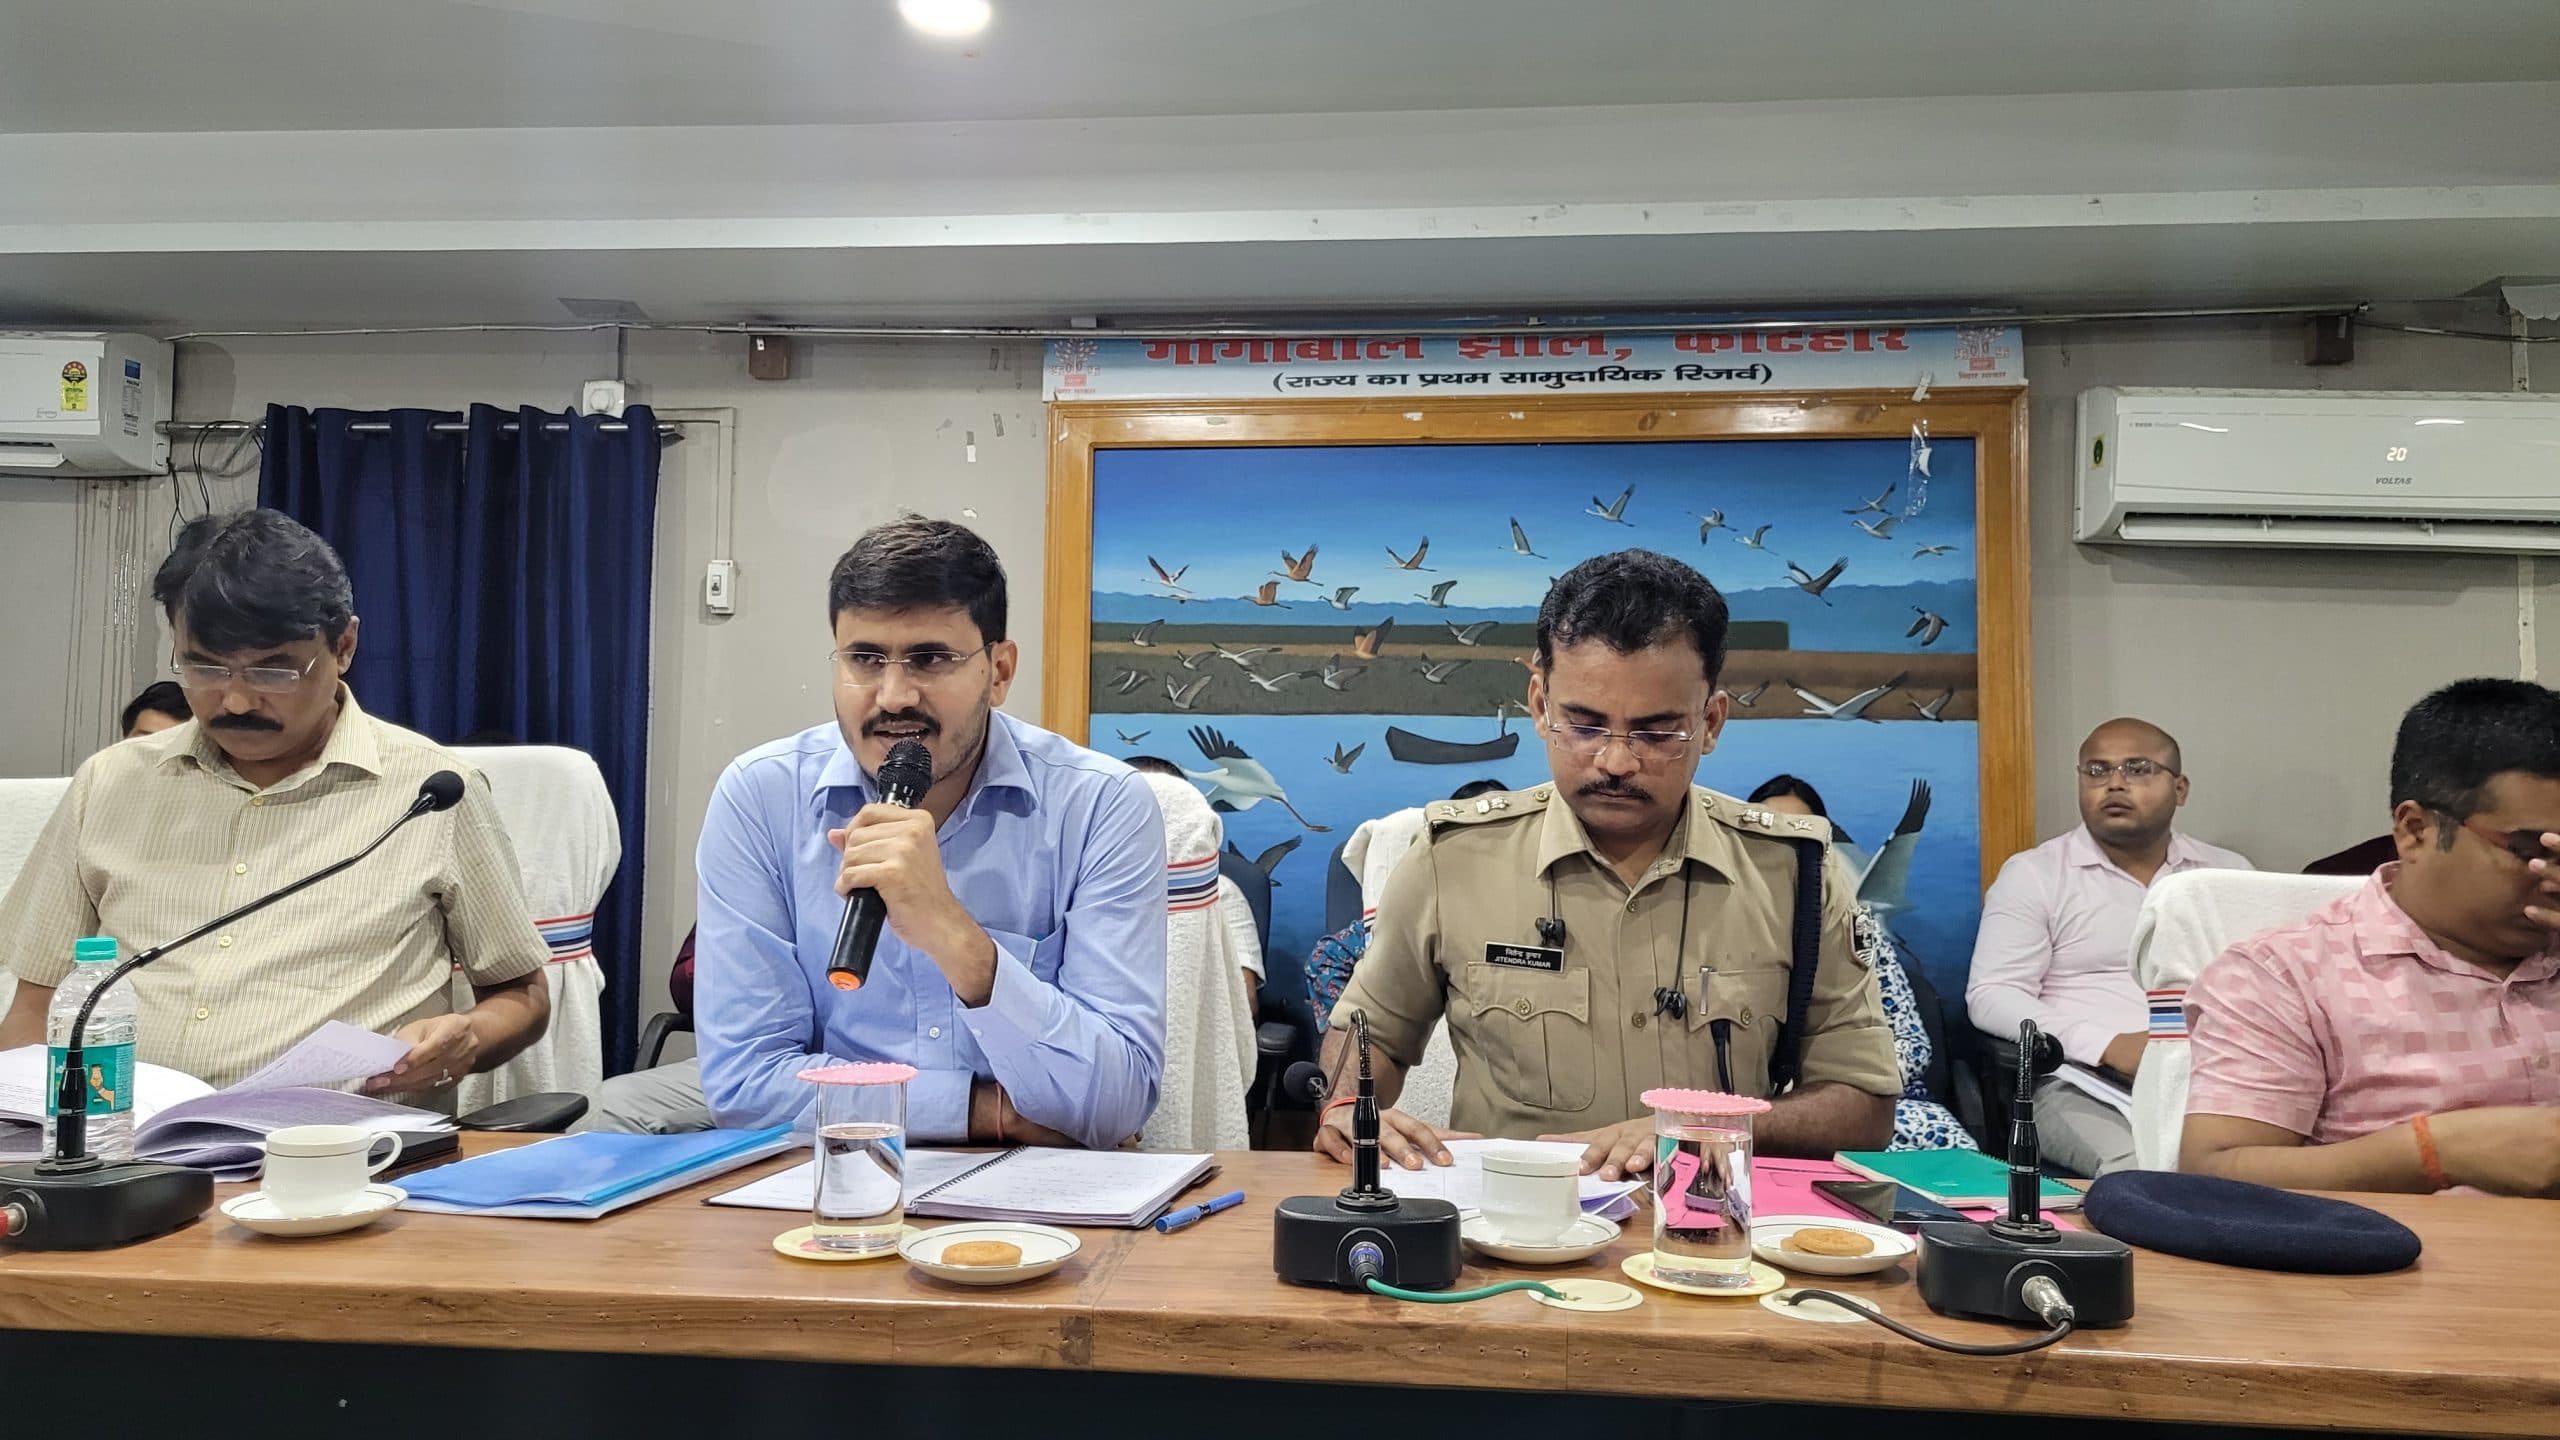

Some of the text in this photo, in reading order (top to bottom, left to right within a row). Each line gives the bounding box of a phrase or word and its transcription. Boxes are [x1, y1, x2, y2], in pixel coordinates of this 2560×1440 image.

[1272, 363, 1773, 392] (राज्य का प्रथम सामुदायिक रिजर्व)
[2386, 446, 2408, 461] 20
[2375, 477, 2413, 485] VOLTAS
[1494, 955, 1552, 969] JITENDRA KUMAR
